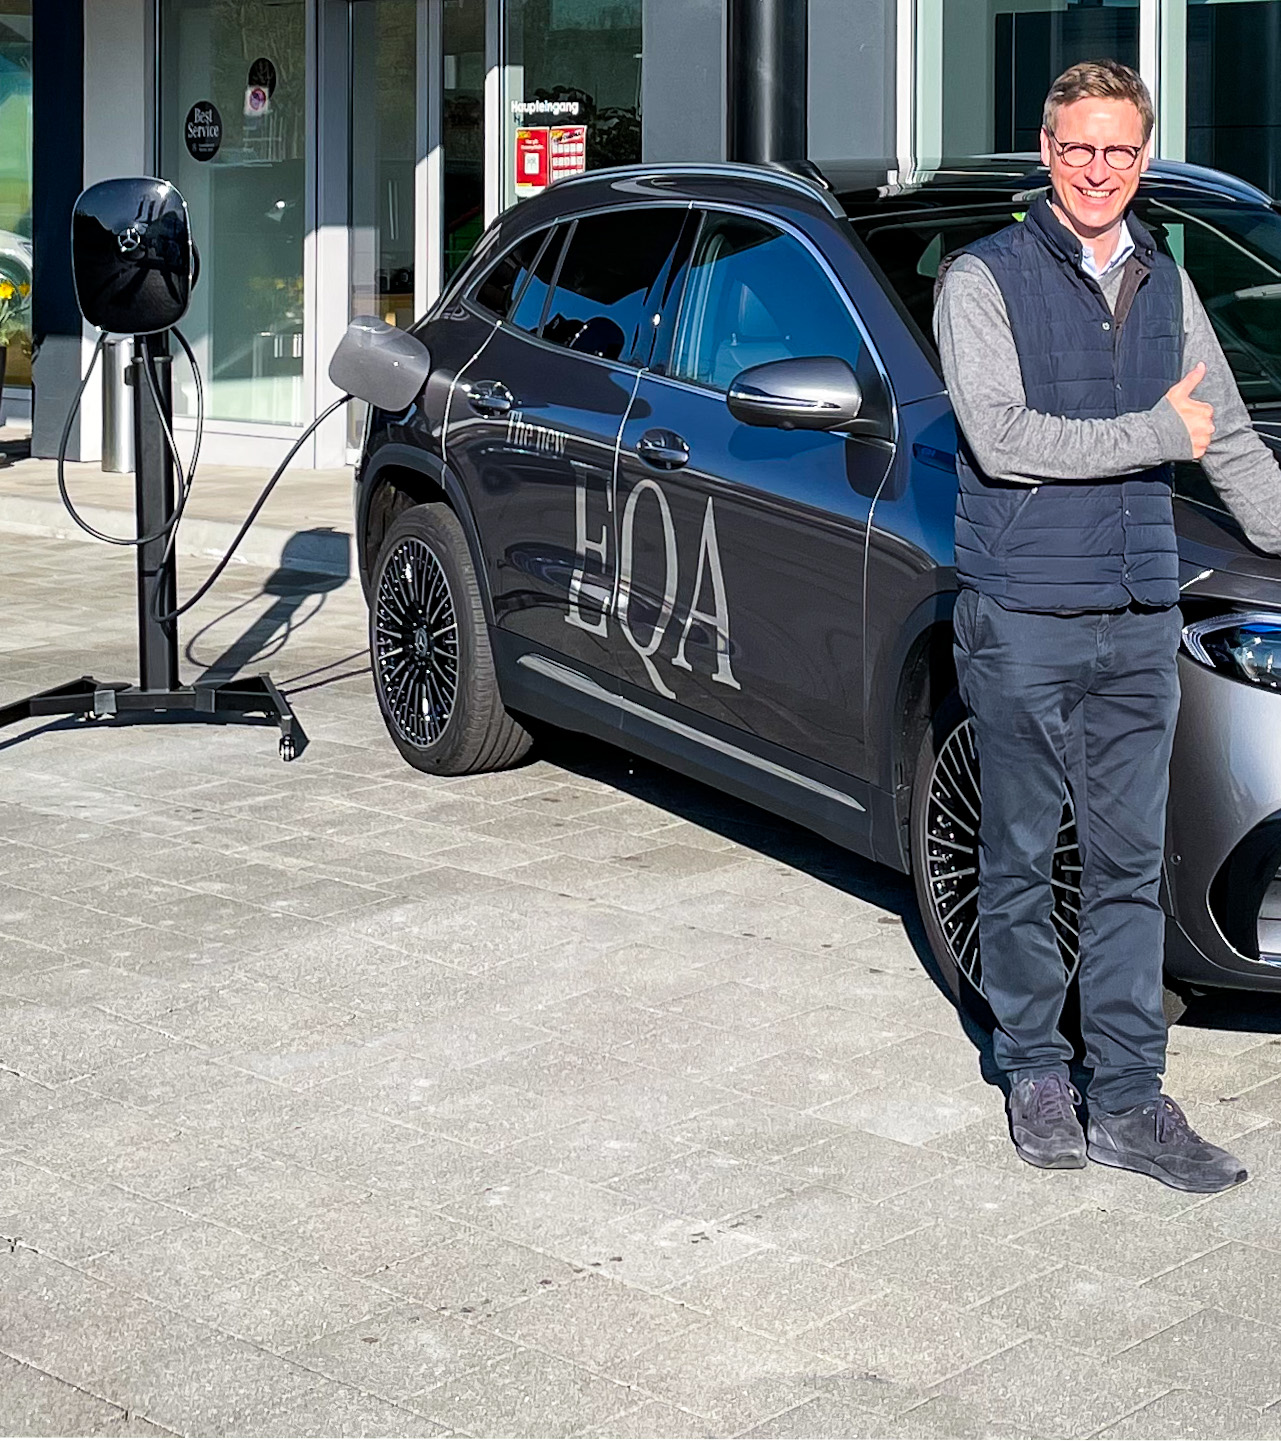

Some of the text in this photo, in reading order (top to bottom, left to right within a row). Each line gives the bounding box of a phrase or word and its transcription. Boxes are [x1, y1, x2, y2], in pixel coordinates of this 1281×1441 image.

[194, 107, 213, 123] Best
[510, 100, 579, 116] Haupteingang
[187, 122, 220, 138] Service
[506, 409, 568, 457] The new
[564, 459, 741, 699] EQA
